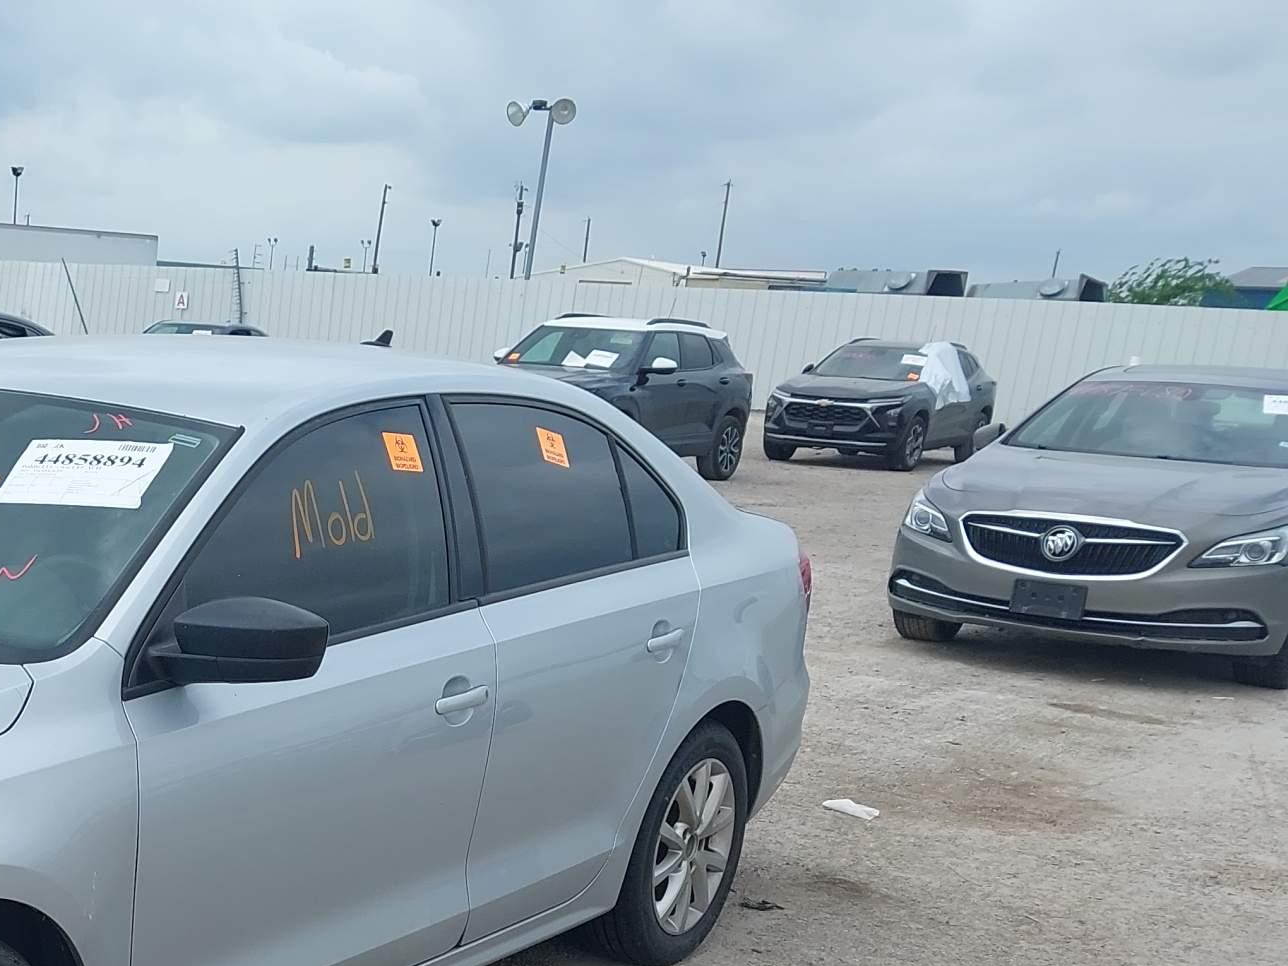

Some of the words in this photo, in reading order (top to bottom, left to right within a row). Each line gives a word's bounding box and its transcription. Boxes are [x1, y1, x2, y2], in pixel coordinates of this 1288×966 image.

[177, 293, 185, 307] A
[33, 453, 148, 469] 44858894
[292, 470, 375, 558] Mold
